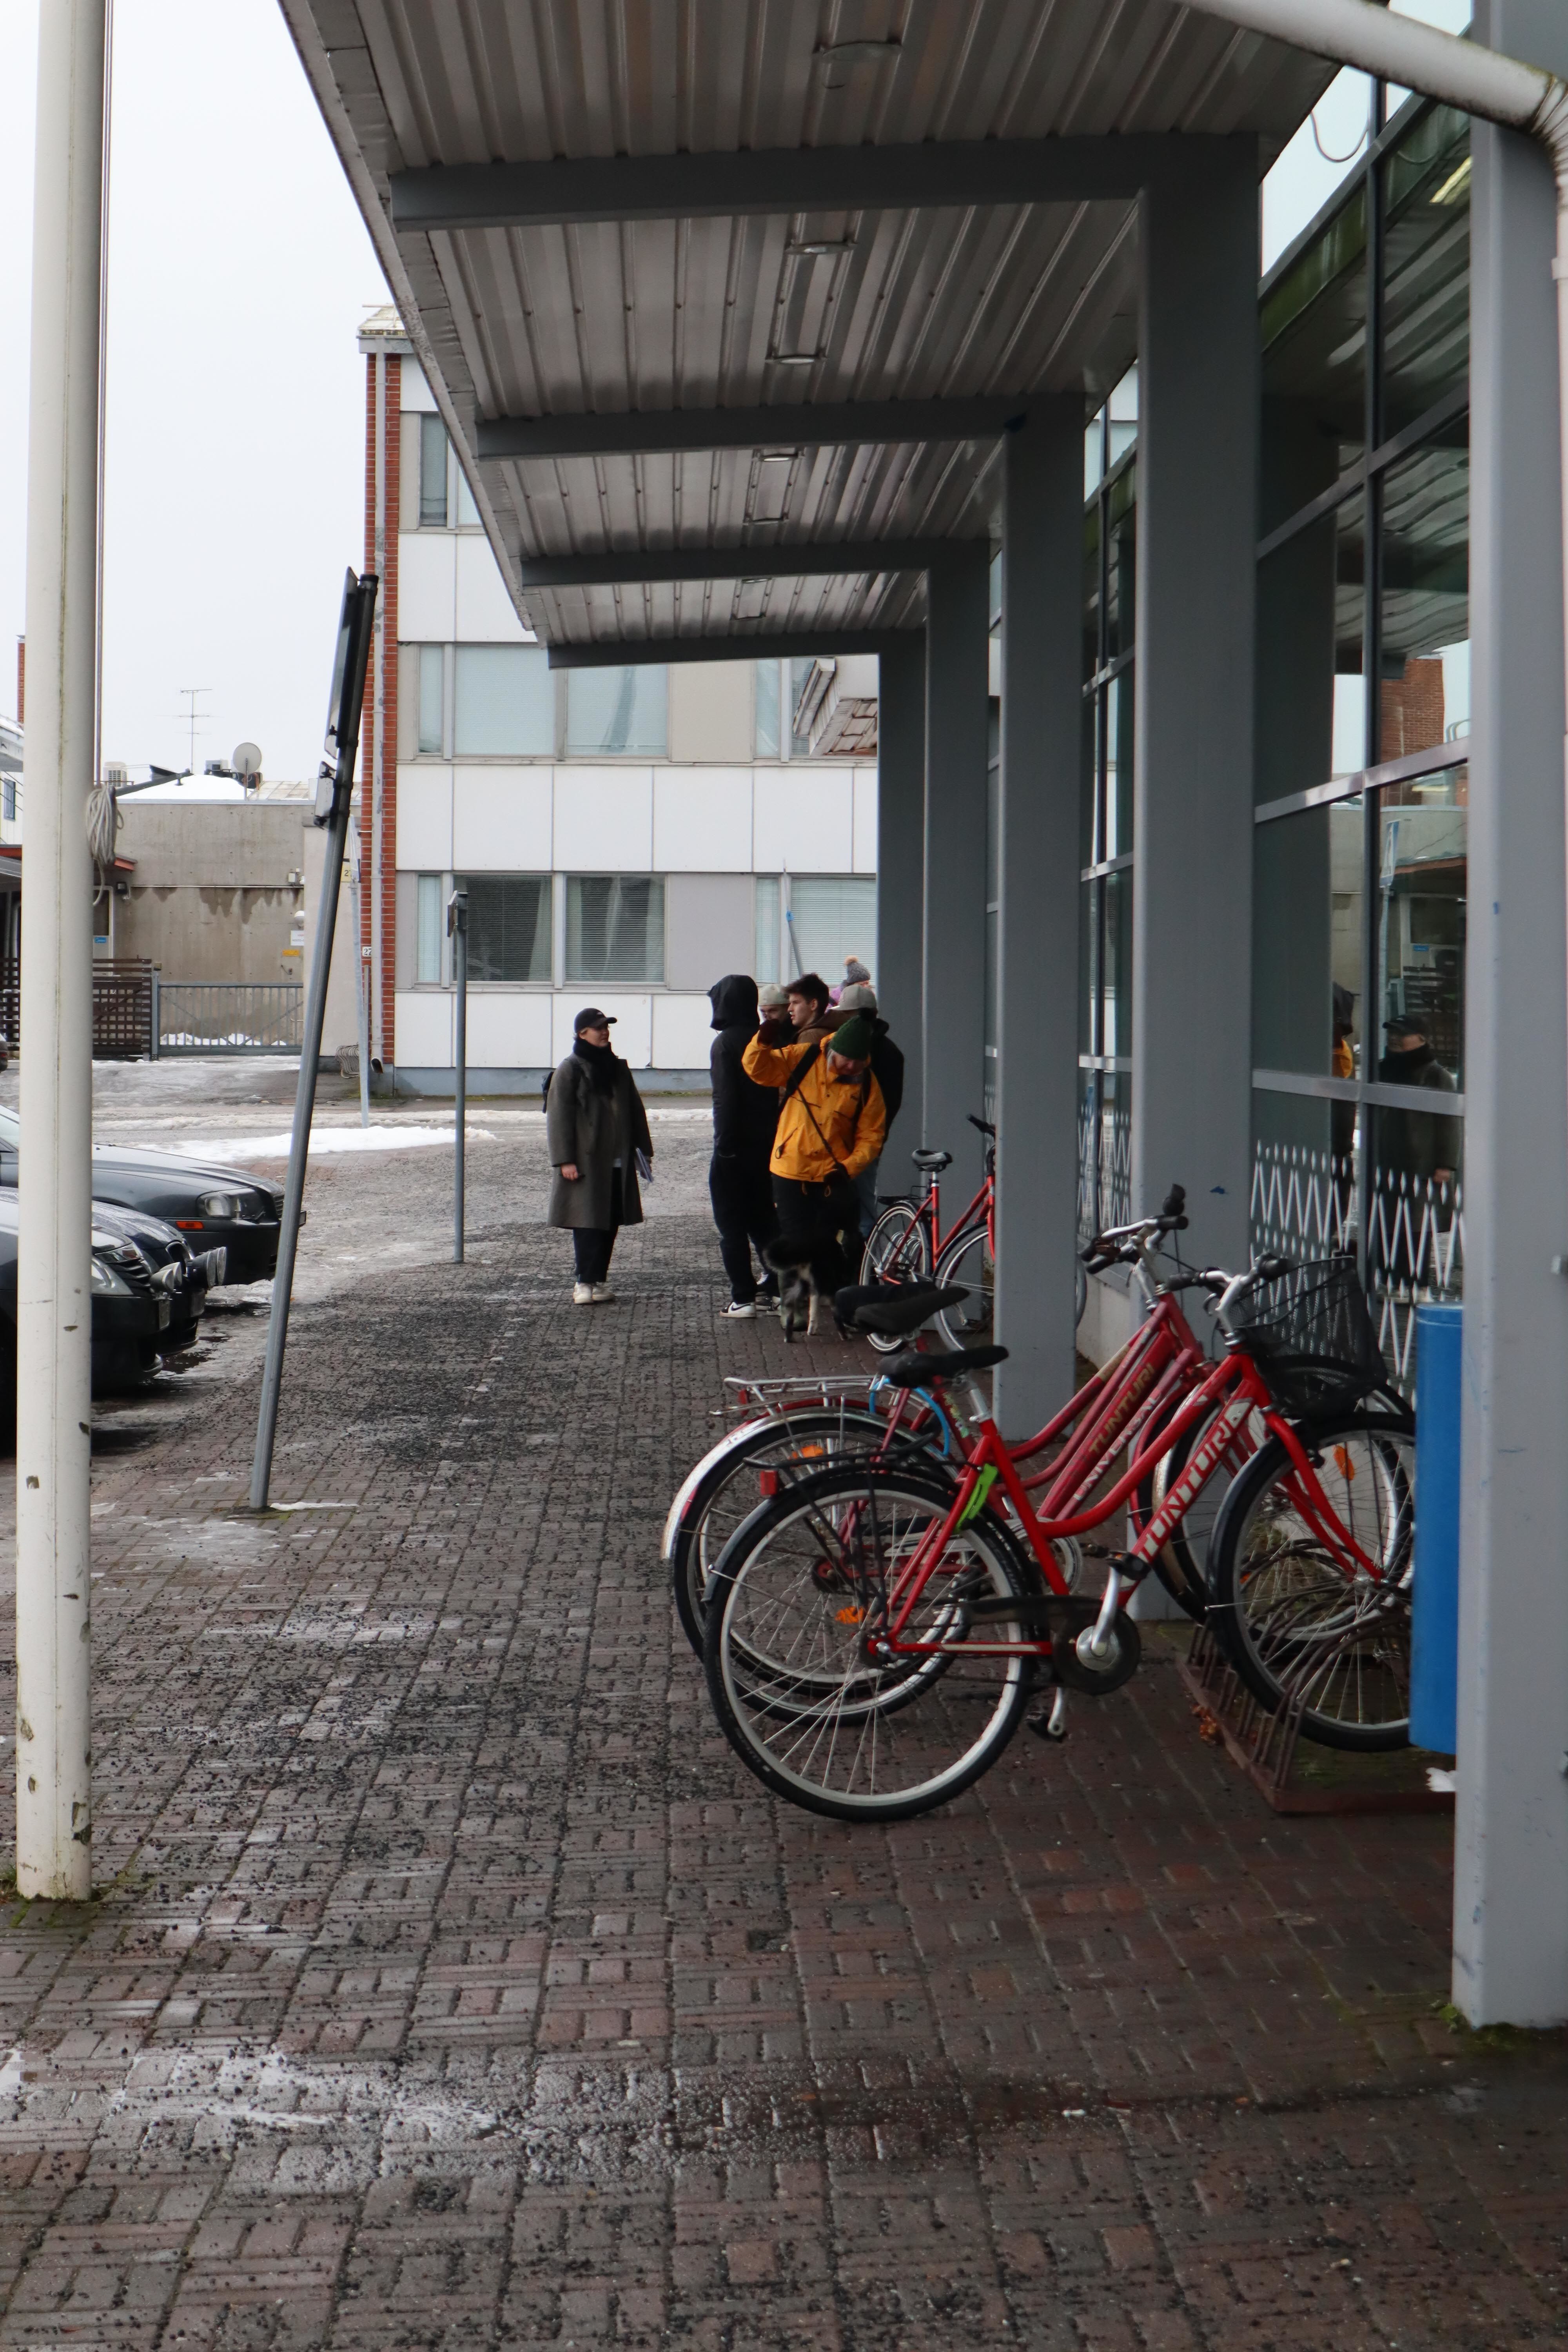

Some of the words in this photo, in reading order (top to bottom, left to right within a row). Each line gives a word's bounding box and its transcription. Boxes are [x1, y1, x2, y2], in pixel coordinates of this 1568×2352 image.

[1073, 1392, 1161, 1501] UNIVERSAL
[1089, 1363, 1154, 1453] TUNTURI
[1138, 1417, 1236, 1560] TUNTURI
